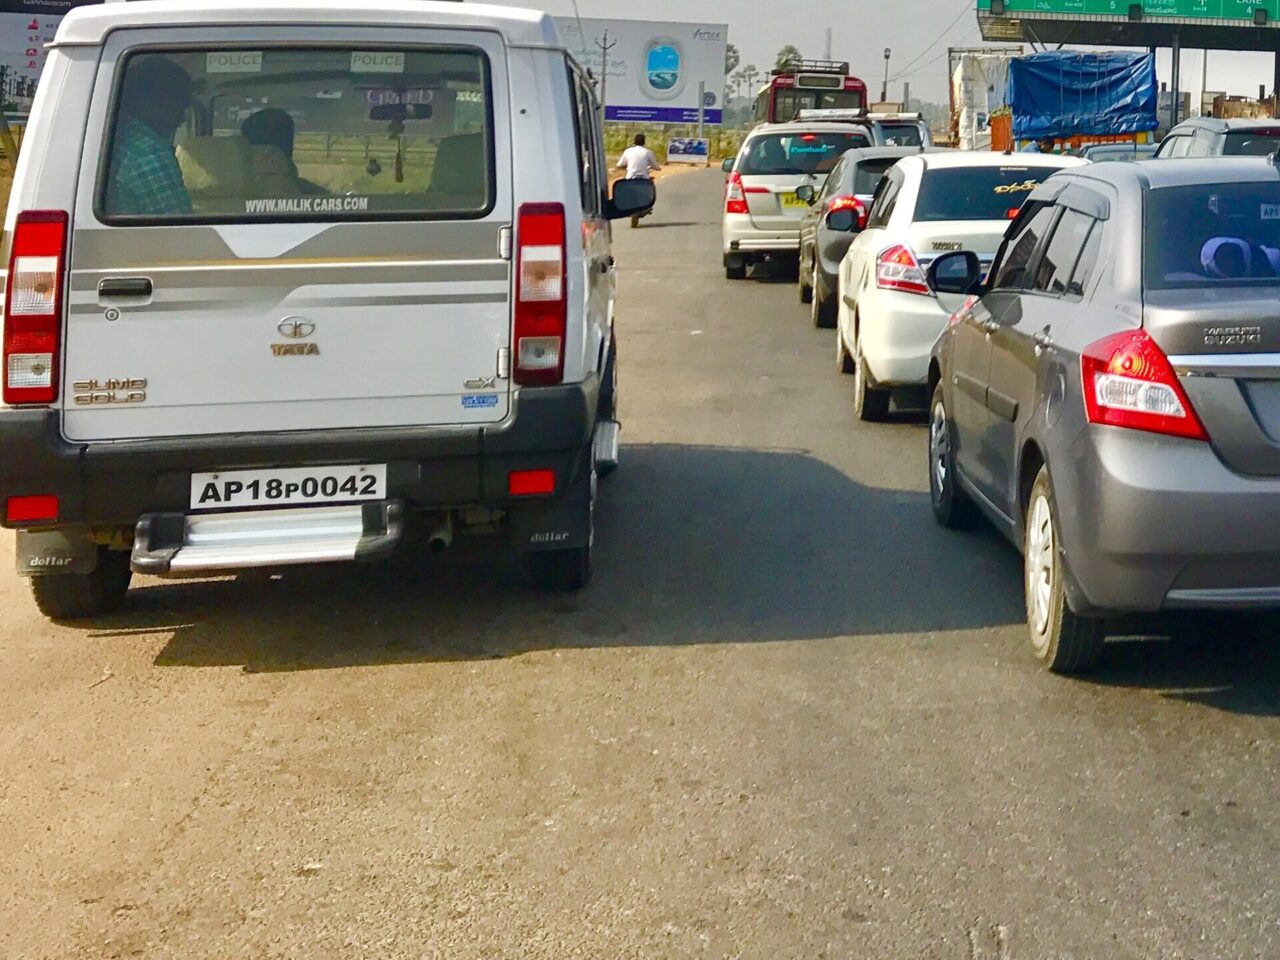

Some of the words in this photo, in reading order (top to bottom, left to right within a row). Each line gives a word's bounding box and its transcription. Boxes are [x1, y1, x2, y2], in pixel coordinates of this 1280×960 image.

[1109, 0, 1117, 10] 5
[1246, 5, 1253, 15] 4
[208, 54, 262, 66] POLICE
[352, 54, 404, 66] POLICE
[245, 198, 311, 213] WWW.MALIK
[313, 197, 368, 211] CARS.COM
[1204, 334, 1261, 345] SUZUKI
[271, 342, 321, 357] TATA
[73, 377, 148, 391] SUMO
[74, 390, 147, 406] GOLD
[529, 531, 570, 544] dollar
[29, 556, 73, 567] dollar
